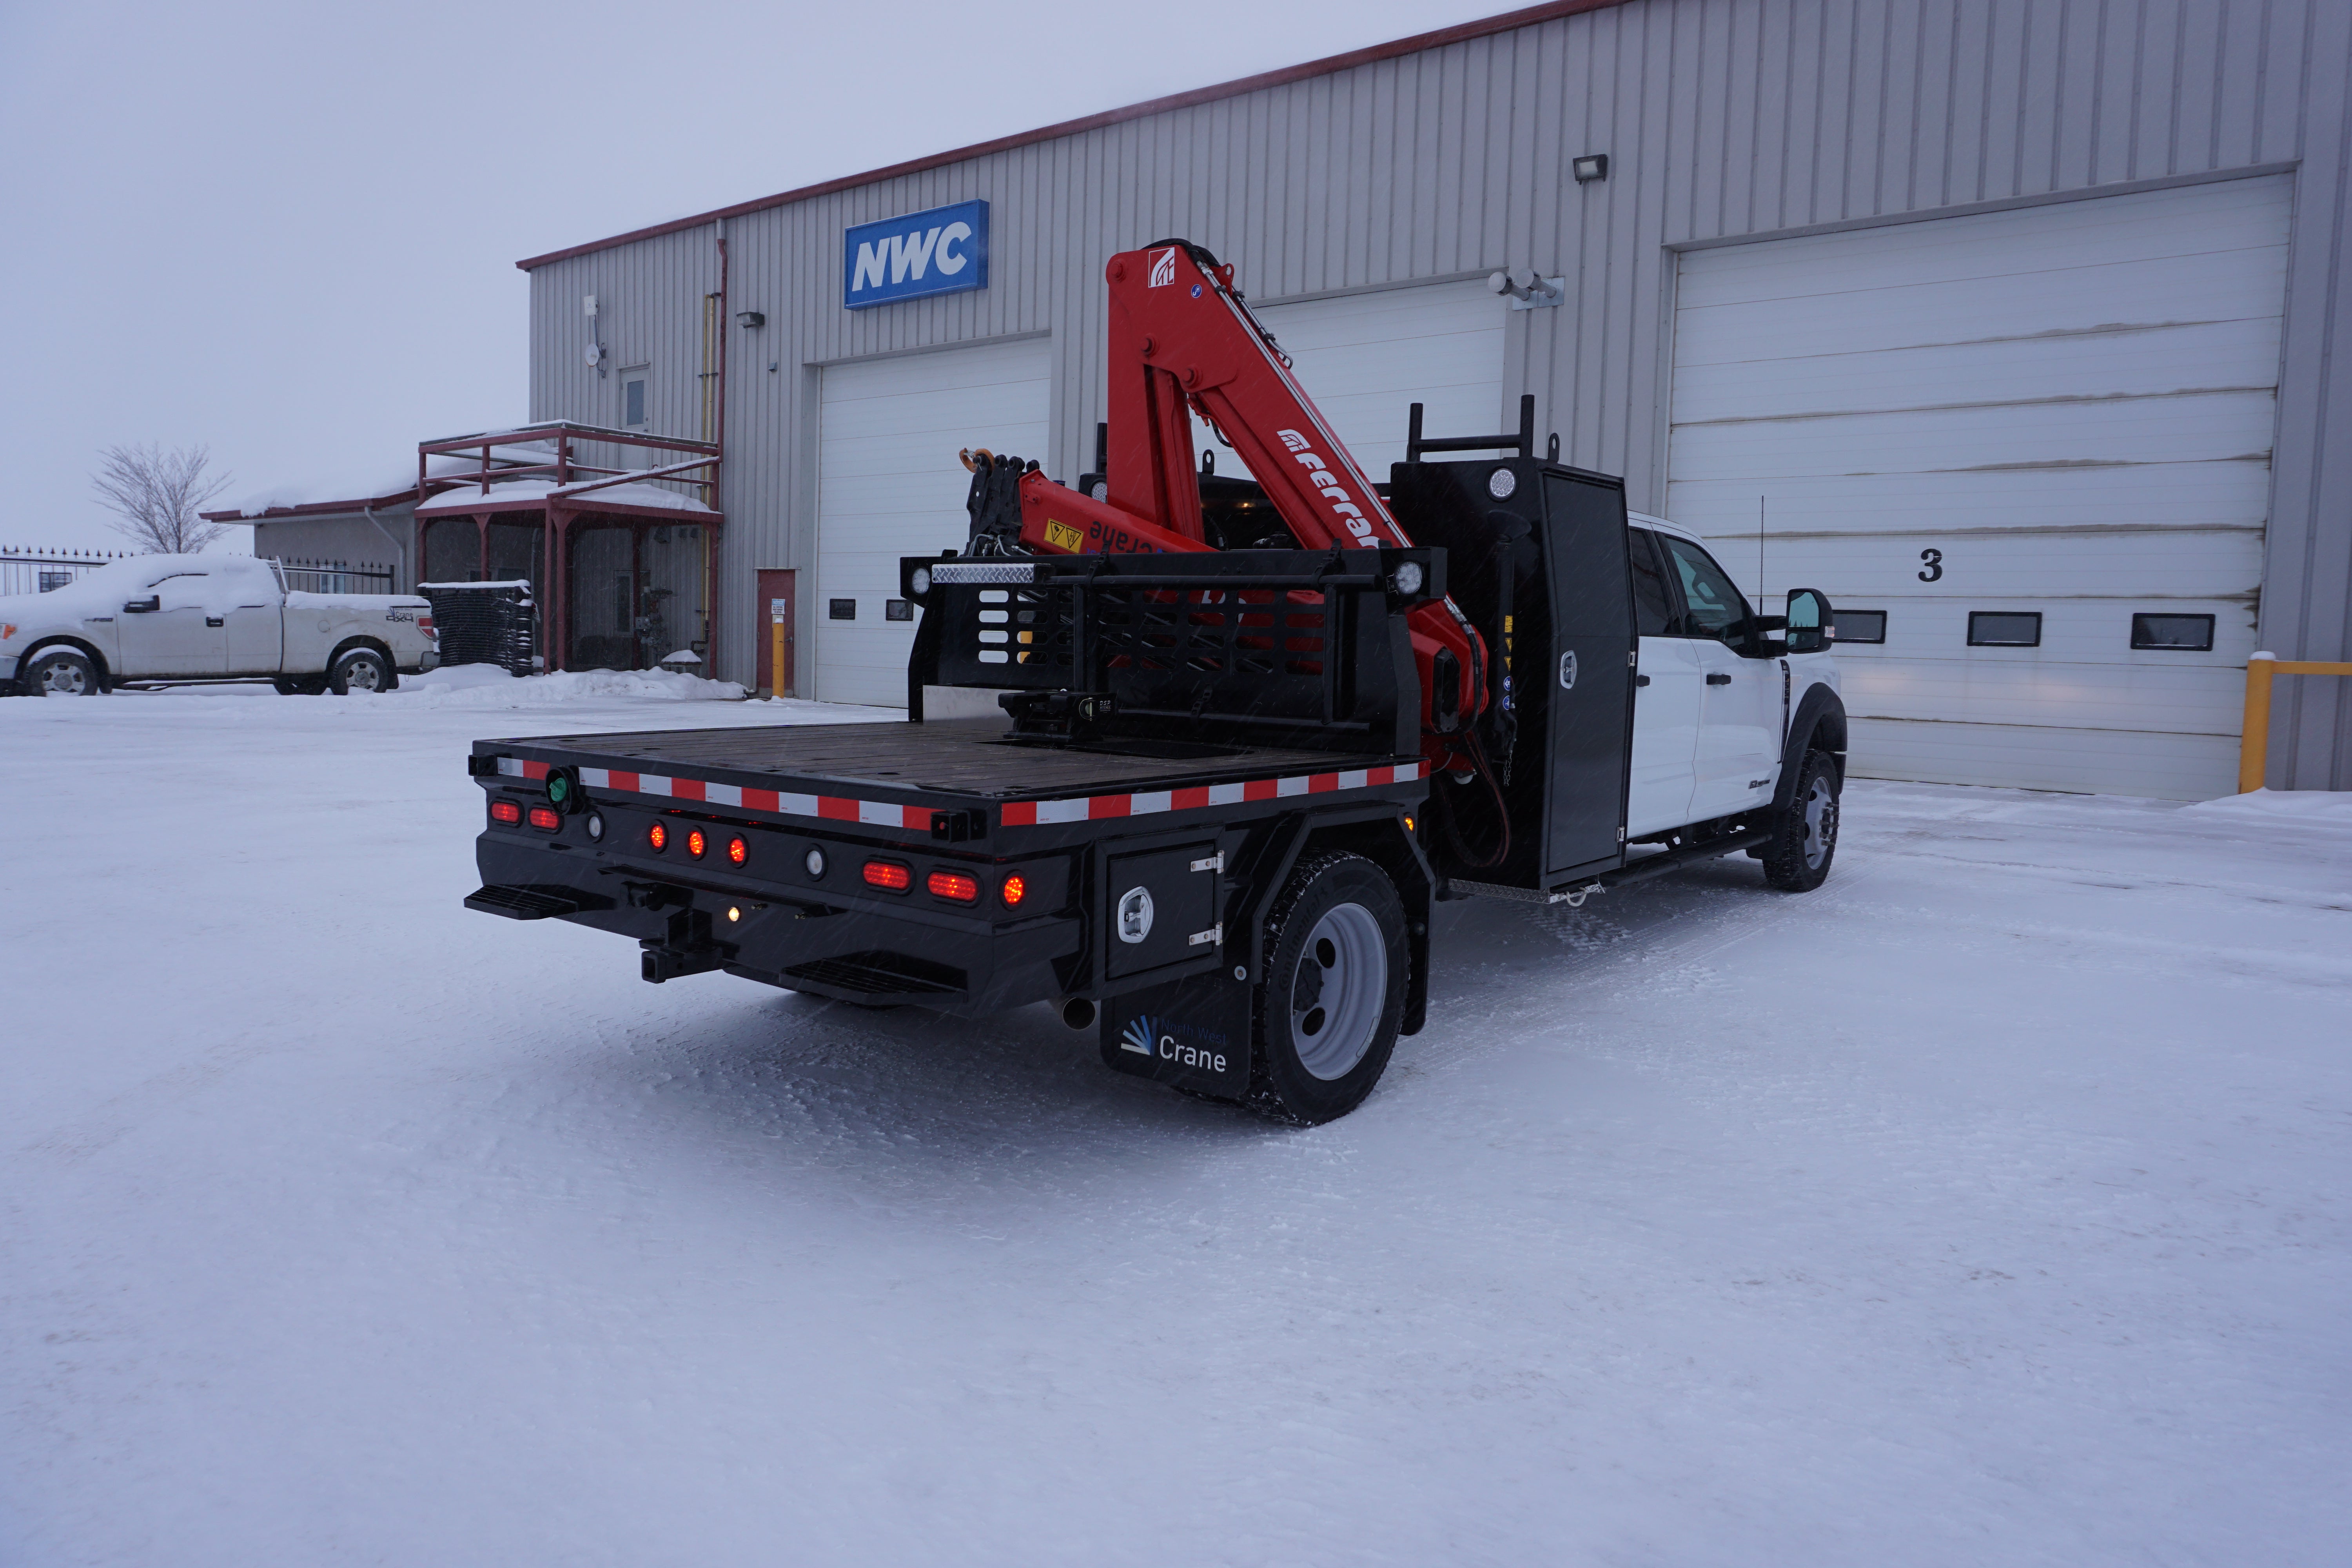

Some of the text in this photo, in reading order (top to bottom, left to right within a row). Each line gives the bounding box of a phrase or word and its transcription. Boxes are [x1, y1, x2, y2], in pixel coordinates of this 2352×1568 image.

[852, 221, 972, 292] NWC
[1295, 453, 1380, 549] Ferrar
[1918, 548, 1942, 582] 3
[1279, 894, 1320, 991] Continental
[1159, 1035, 1227, 1073] Crane
[1161, 1019, 1227, 1045] North West
